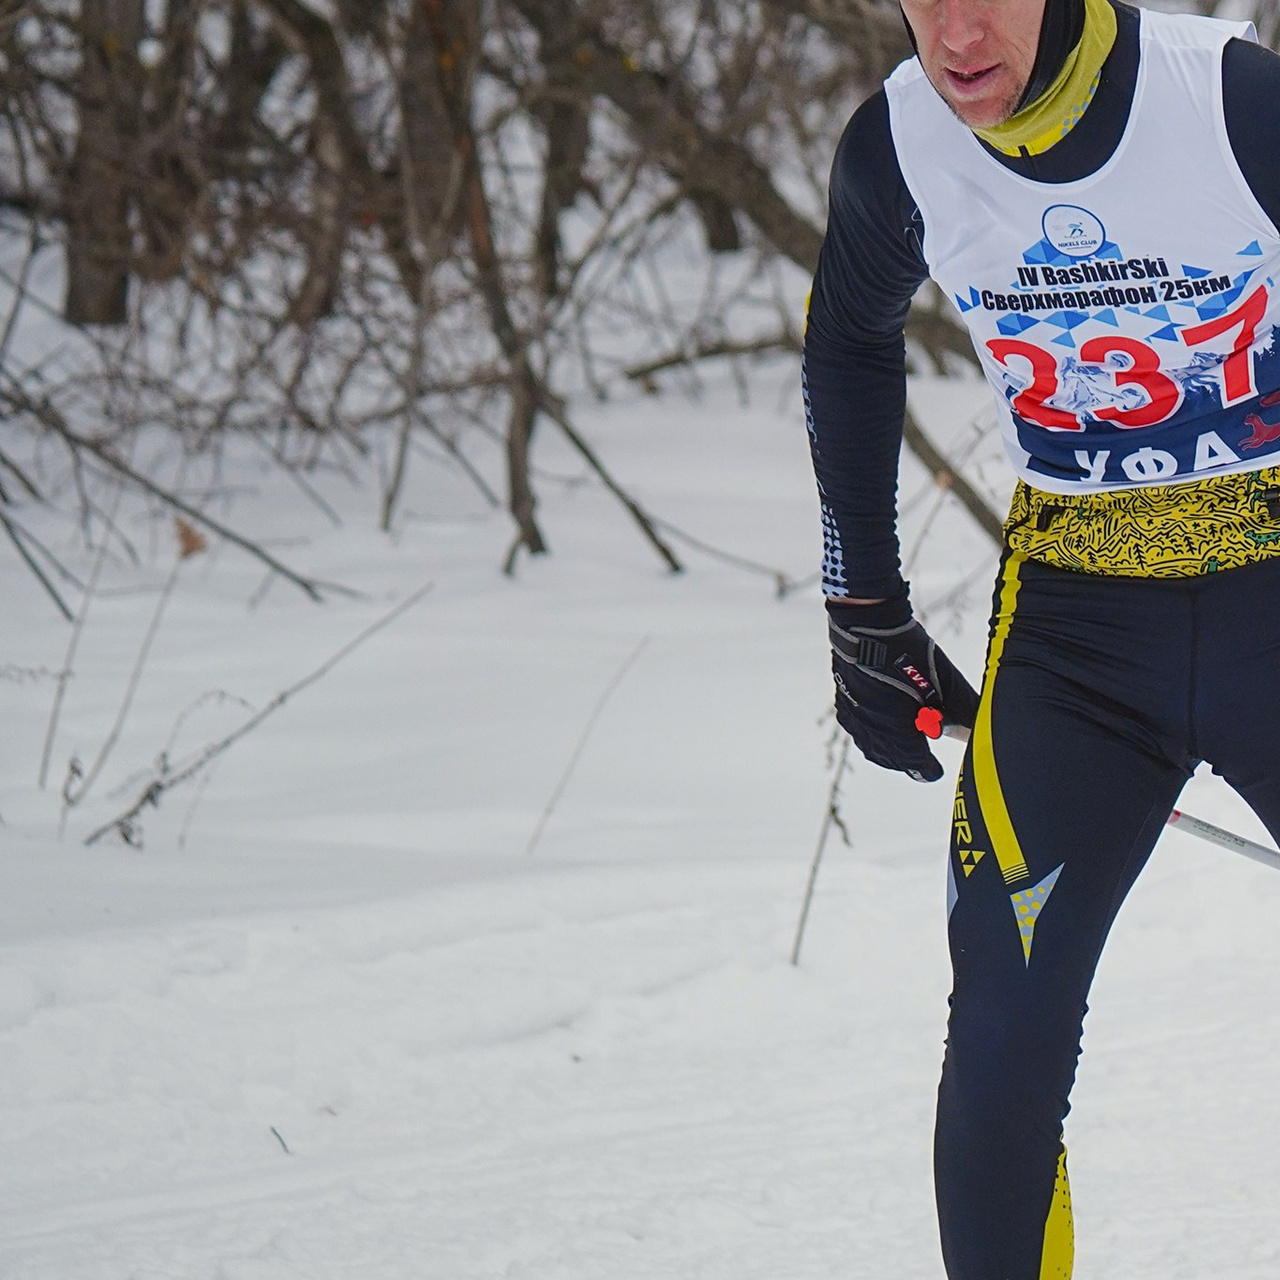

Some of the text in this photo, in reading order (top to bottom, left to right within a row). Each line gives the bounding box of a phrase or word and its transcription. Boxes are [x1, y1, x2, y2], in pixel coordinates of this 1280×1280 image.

[980, 275, 1232, 314] Сверхмарафон 25км
[1017, 258, 1170, 287] IV BashkirSki
[985, 284, 1269, 431] 237
[1074, 431, 1242, 482] УФА
